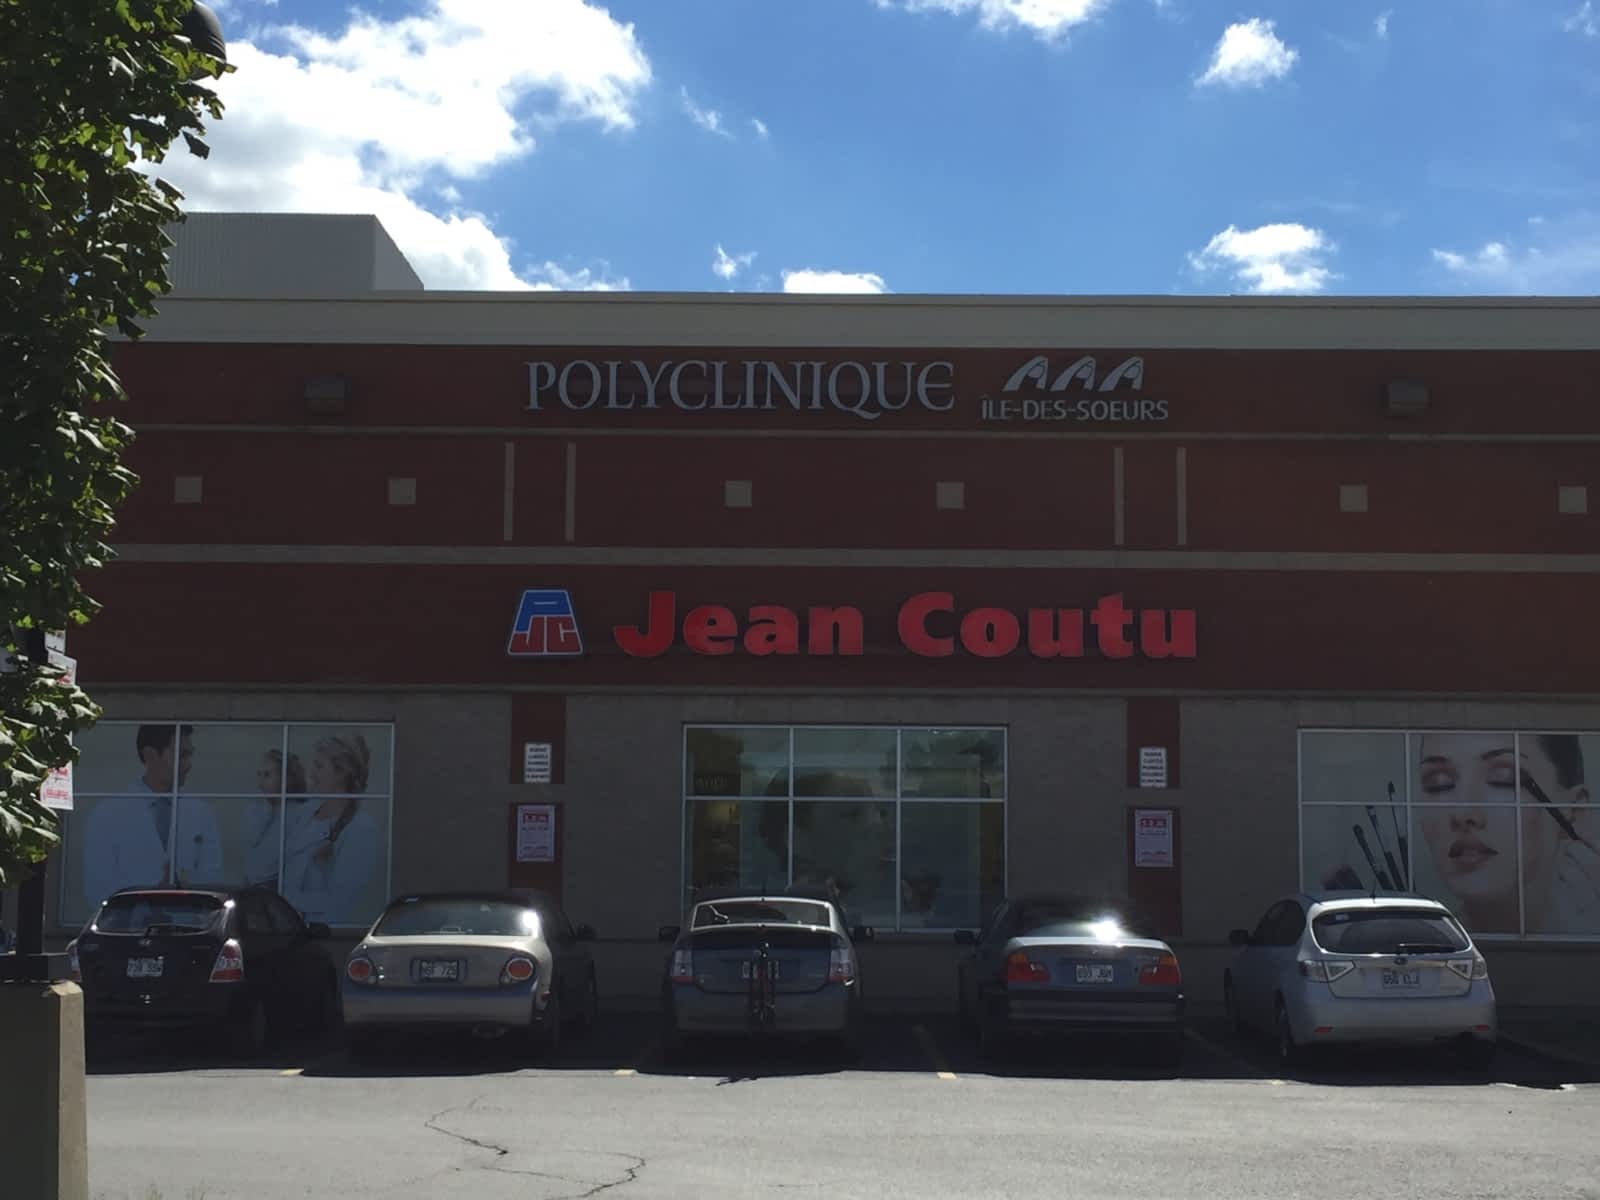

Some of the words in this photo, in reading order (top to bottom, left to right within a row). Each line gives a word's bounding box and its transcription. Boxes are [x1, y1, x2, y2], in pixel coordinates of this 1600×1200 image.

[524, 359, 956, 421] POLYCLINIQUE
[980, 394, 1169, 422] ÎLE-DES-SOEURS
[613, 591, 865, 658] Jean
[897, 592, 1198, 660] Coutu
